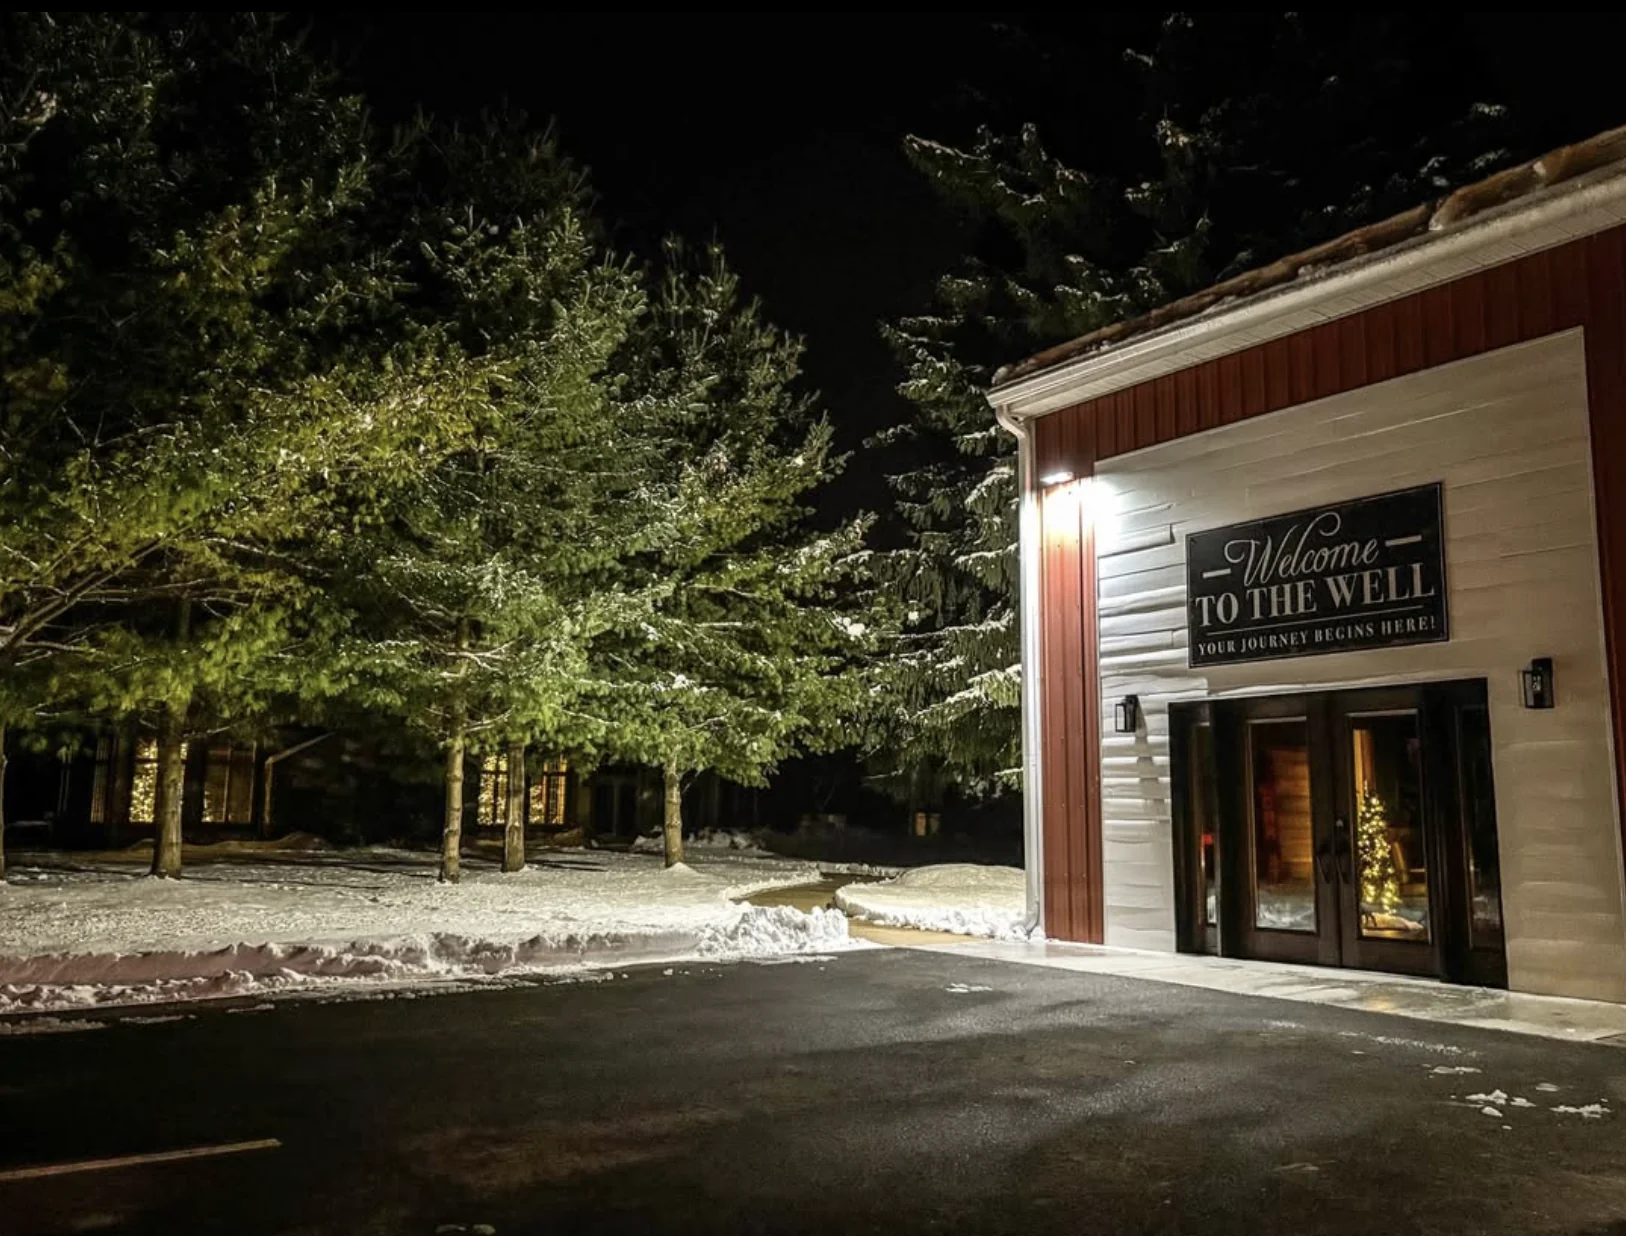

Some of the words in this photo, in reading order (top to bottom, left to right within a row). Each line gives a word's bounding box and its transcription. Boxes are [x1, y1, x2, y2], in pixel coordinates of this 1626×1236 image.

[1224, 511, 1379, 586] Welcome
[1195, 592, 1239, 627] TO
[1246, 579, 1317, 621] THE
[1324, 562, 1435, 609] WELL
[1198, 640, 1236, 656] YOUR
[1240, 630, 1308, 653] JOURNEY
[1314, 623, 1375, 642] BEGINS
[1381, 615, 1436, 635] HERE!
